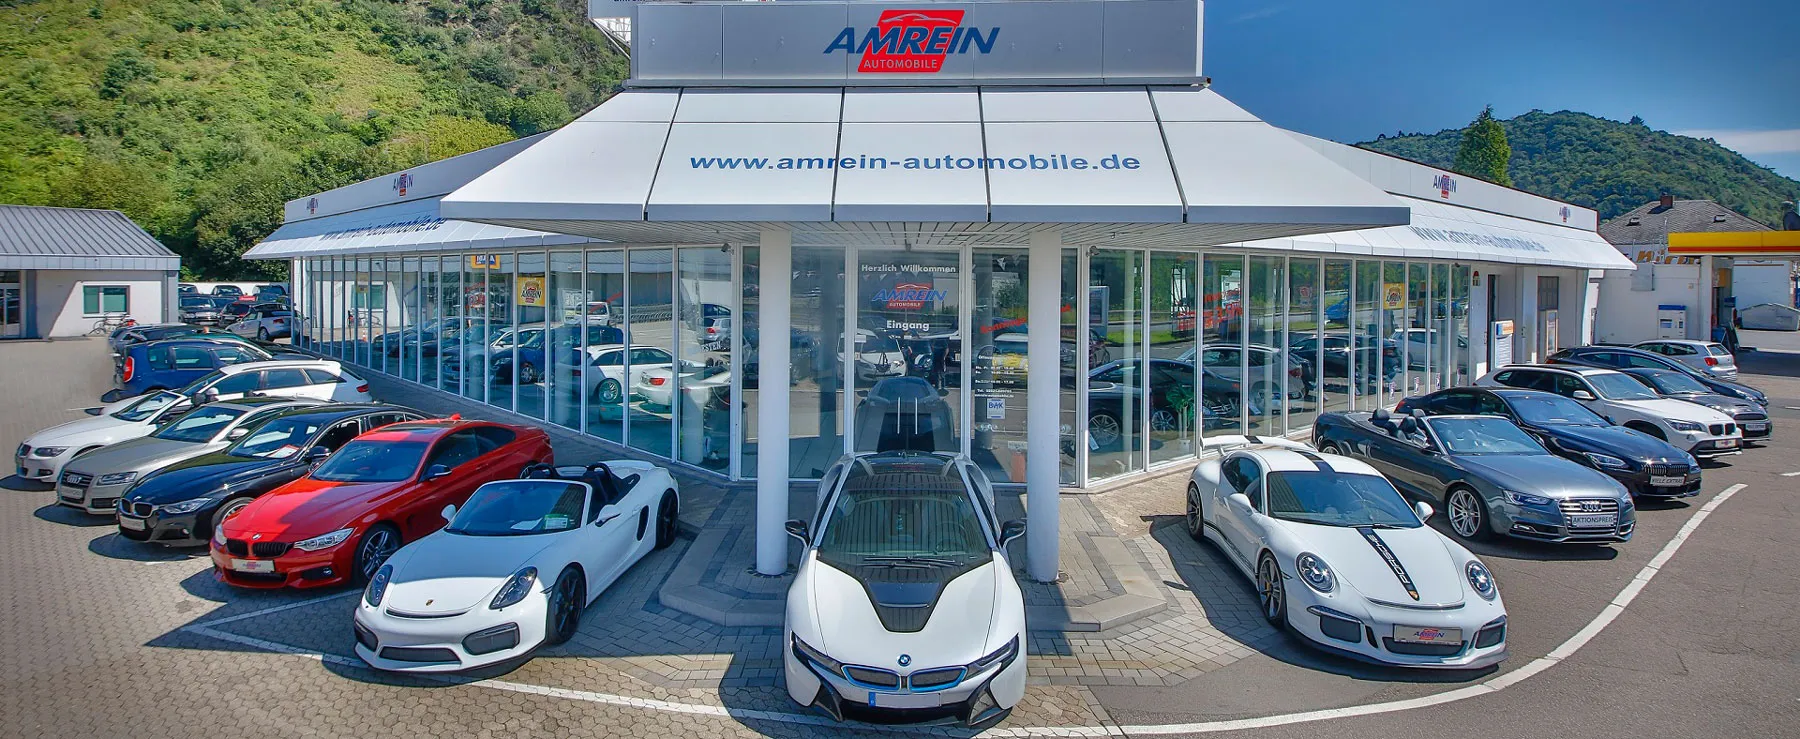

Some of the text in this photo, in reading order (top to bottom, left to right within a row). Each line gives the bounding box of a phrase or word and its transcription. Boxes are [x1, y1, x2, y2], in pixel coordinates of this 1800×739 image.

[823, 26, 1000, 54] AMREIN
[863, 59, 938, 69] AUTOMOBILE
[690, 153, 1140, 171] www.amrein-automobile.de
[1432, 175, 1457, 193] AMREIN
[861, 264, 956, 273] Herzlich Willkommen
[872, 289, 948, 301] AMREIN
[886, 320, 930, 331] Eingang
[1367, 534, 1411, 584] PORSCHE
